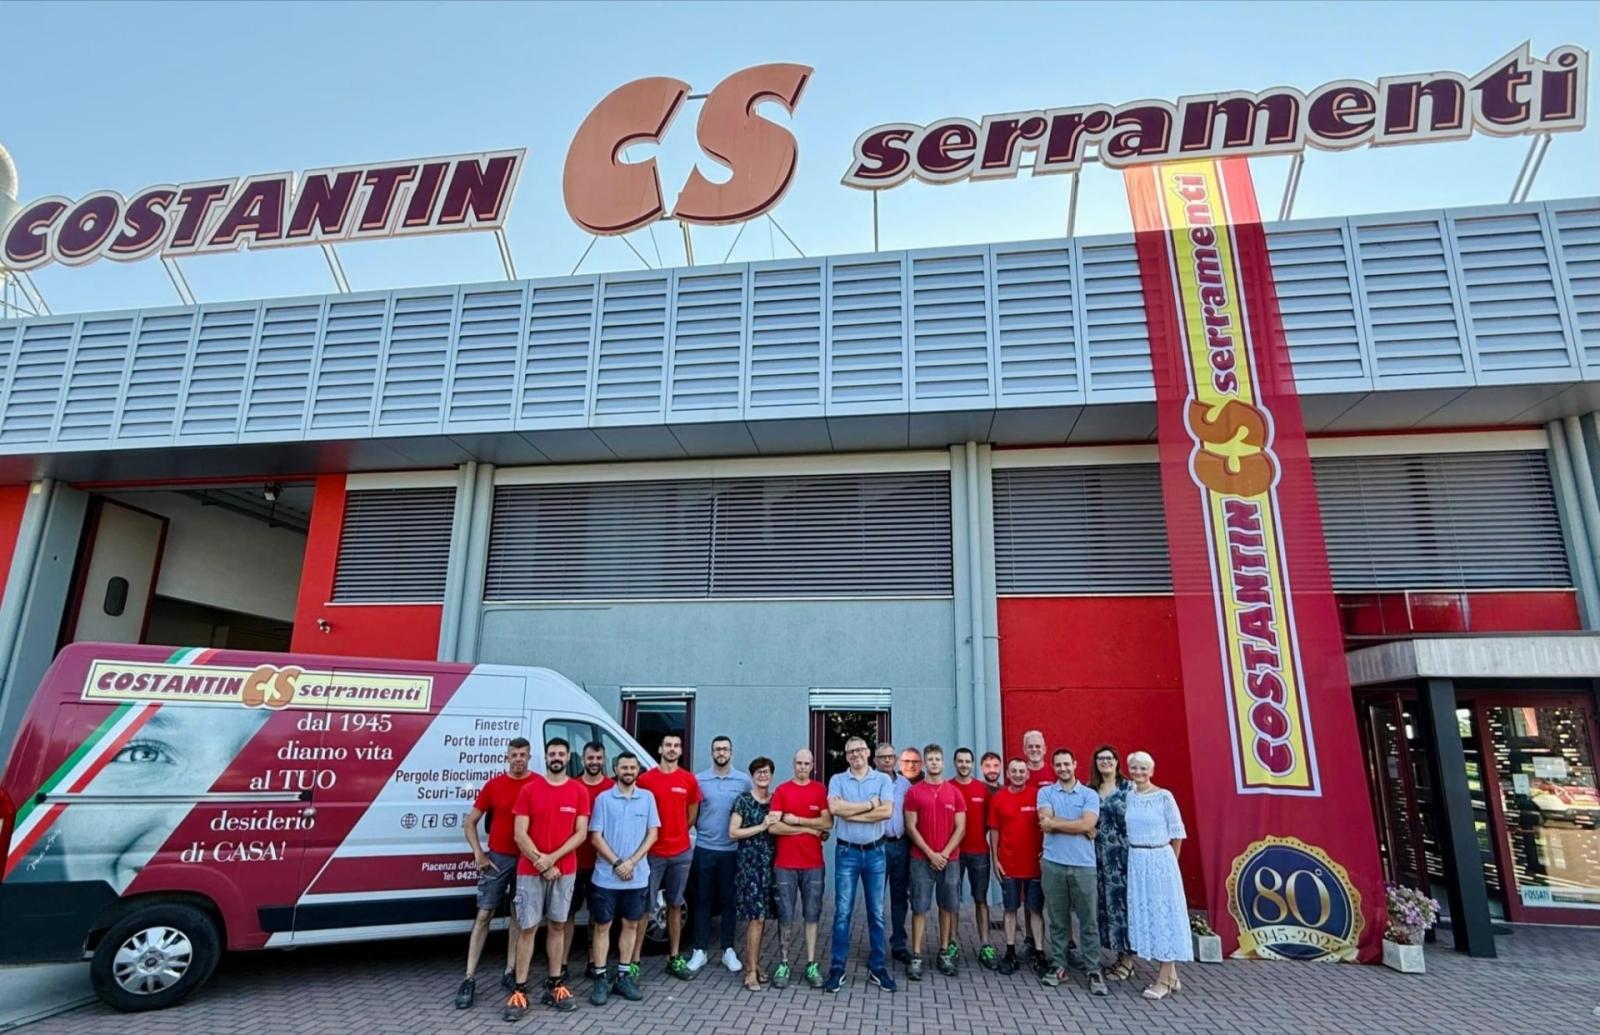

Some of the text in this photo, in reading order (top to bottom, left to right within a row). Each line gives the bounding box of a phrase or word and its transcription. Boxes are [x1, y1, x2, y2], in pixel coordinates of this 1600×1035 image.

[4, 51, 1580, 263] COSTANTIN CS serramenti
[1173, 175, 1293, 775] COSTANTIN CS serramenti
[96, 666, 423, 708] COSTANTIN CS serramenti
[297, 713, 393, 733] dal 1945
[474, 718, 520, 731] Finestre
[277, 741, 394, 761] diamo vita
[443, 734, 511, 748] Porte intern
[459, 751, 508, 764] Portonci
[249, 768, 337, 791] al TUO
[395, 769, 440, 785] Pergole
[417, 786, 481, 801] Scuri-Tapp
[210, 809, 315, 832] desiderio
[180, 840, 287, 863] di CASA!
[421, 861, 457, 872] Piacenza
[443, 871, 456, 881] Tel.
